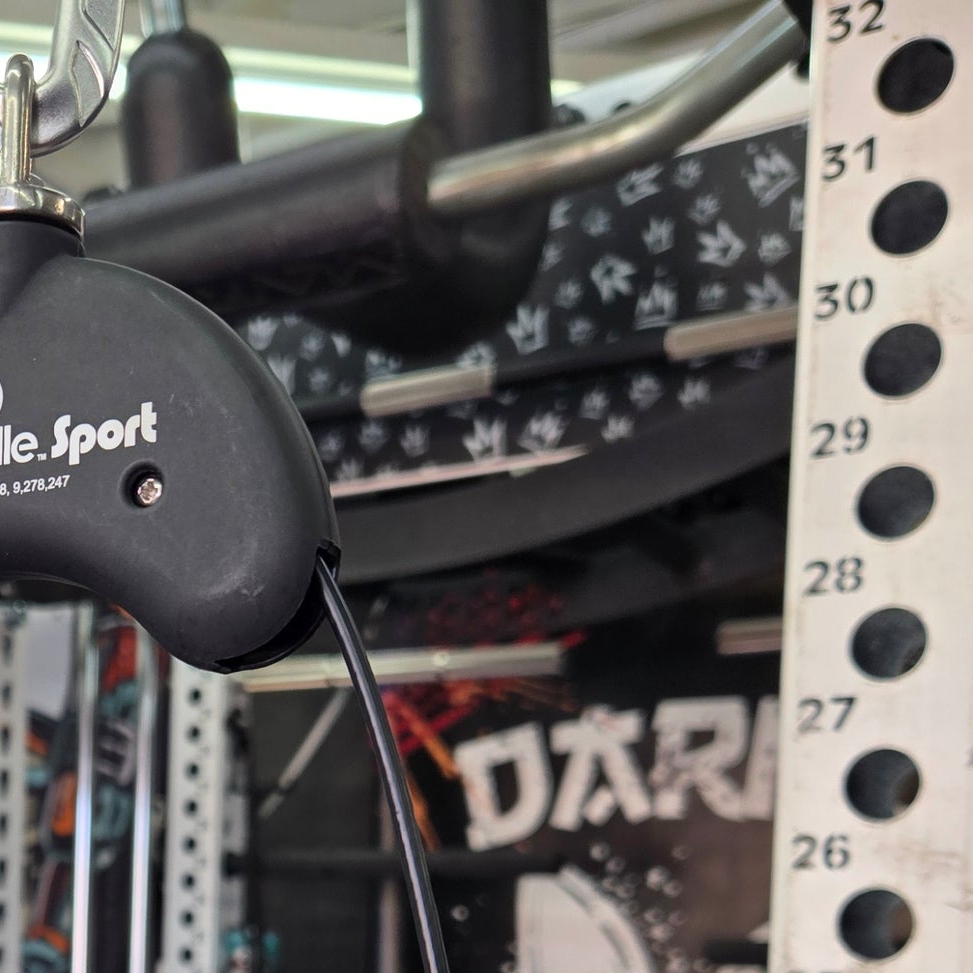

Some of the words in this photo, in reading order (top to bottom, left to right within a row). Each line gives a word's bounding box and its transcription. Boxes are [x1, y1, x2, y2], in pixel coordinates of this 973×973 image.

[828, 0, 885, 43] 32
[823, 136, 876, 182] 31
[816, 276, 875, 320] 30
[50, 401, 158, 467] Sport
[812, 417, 871, 458] 29
[13, 474, 71, 496] 9,278,247
[804, 556, 864, 597] 28
[798, 696, 857, 732] 27
[792, 835, 850, 869] 26
